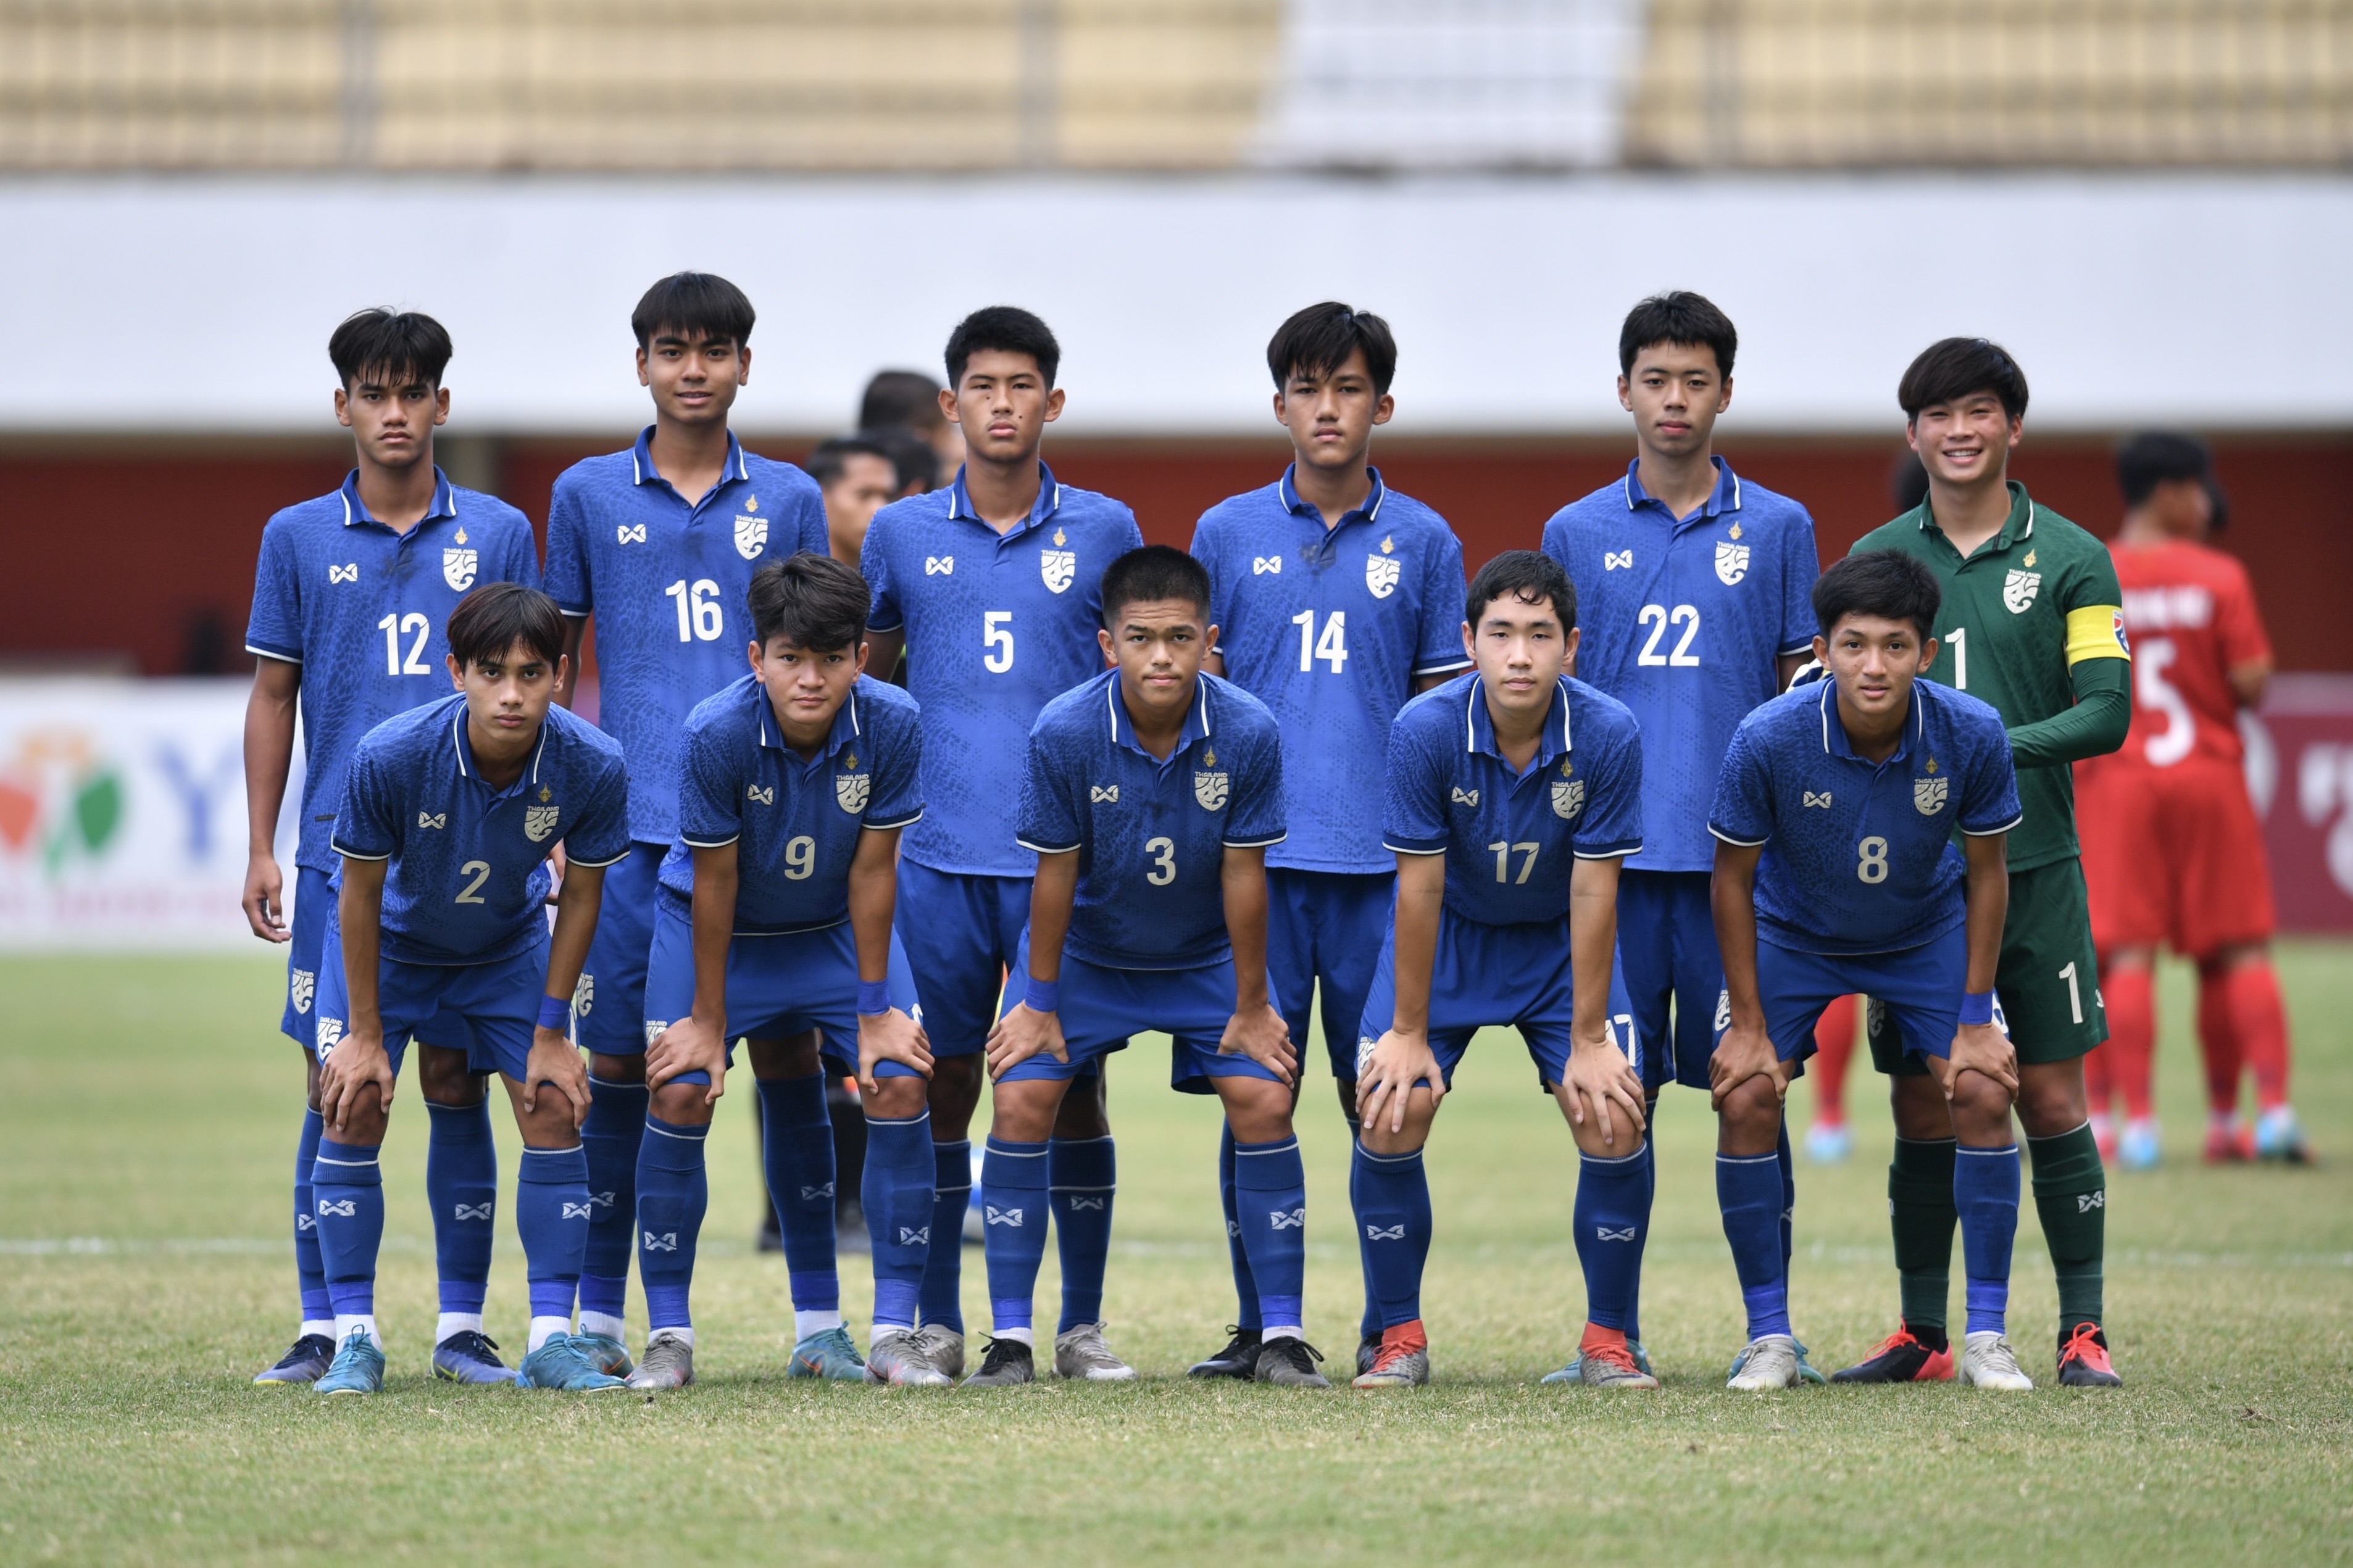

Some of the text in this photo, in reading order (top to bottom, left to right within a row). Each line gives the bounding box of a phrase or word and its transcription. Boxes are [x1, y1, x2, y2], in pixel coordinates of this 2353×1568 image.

[665, 579, 723, 642] 16
[1638, 604, 1700, 666] 22
[378, 612, 431, 676] 12
[984, 611, 1014, 673] 5
[1293, 610, 1347, 674] 14
[1945, 628, 1967, 690] 1
[2137, 637, 2196, 767] 5
[1551, 780, 1584, 788] THAILAND
[455, 860, 490, 904] 2
[785, 836, 815, 880] 9
[1145, 837, 1176, 886] 3
[1488, 841, 1539, 884] 17
[1858, 836, 1888, 884] 8
[2059, 961, 2083, 1024] 1
